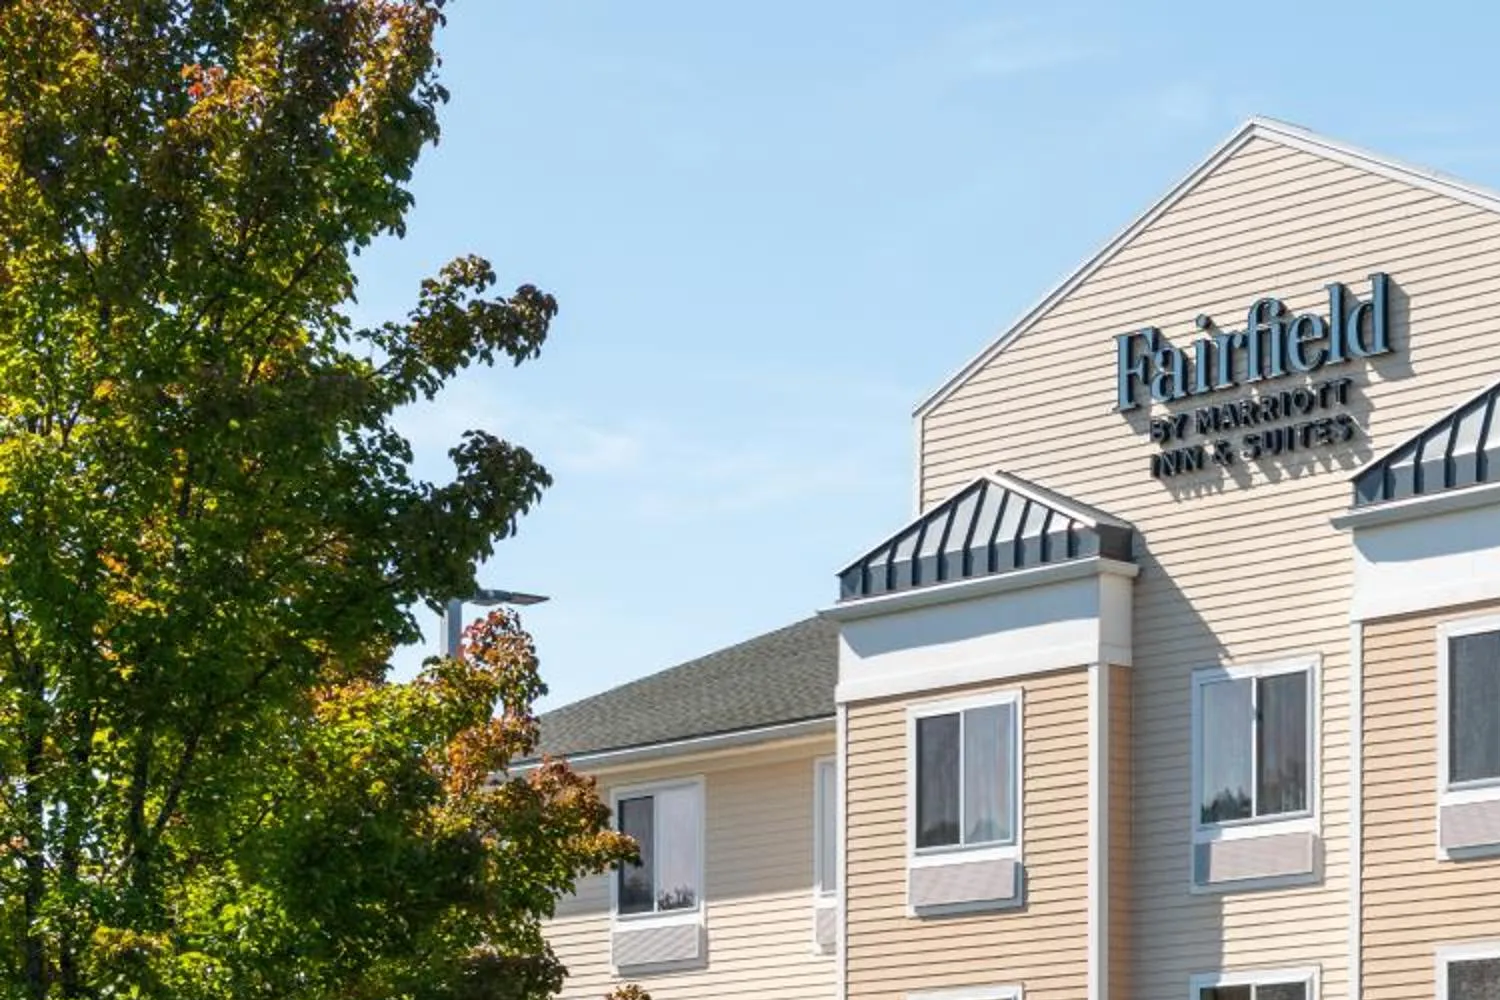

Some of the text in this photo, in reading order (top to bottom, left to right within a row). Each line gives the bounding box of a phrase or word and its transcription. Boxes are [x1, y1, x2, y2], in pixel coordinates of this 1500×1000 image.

[1113, 271, 1391, 413] Fairfield
[1150, 377, 1353, 445] BY MARRIOTT
[1151, 414, 1354, 478] INN & SUITES
